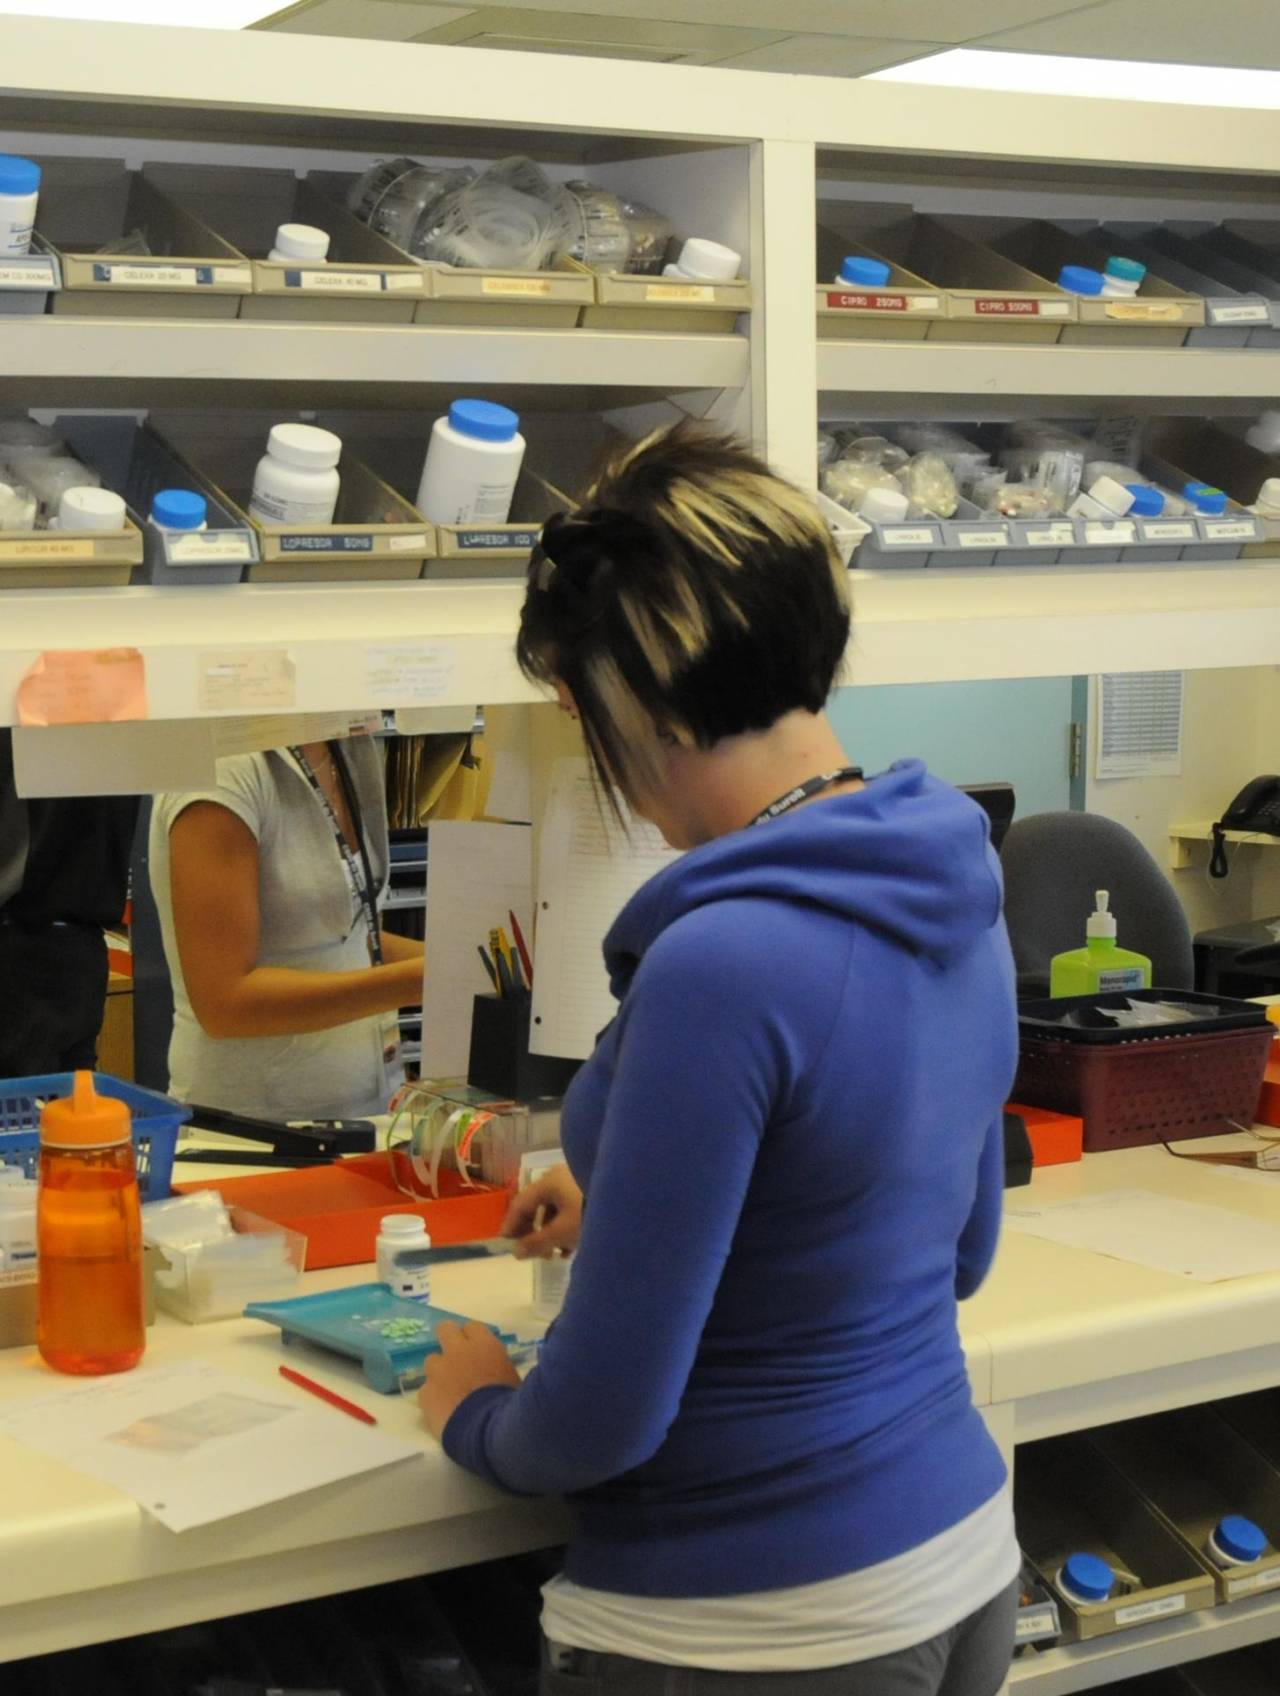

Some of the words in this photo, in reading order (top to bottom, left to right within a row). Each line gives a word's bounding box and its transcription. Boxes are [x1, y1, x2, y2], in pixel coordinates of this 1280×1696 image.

[839, 295, 868, 306] CIPRO
[978, 302, 1006, 312] CIPRO
[282, 536, 333, 550] LOPRESOR
